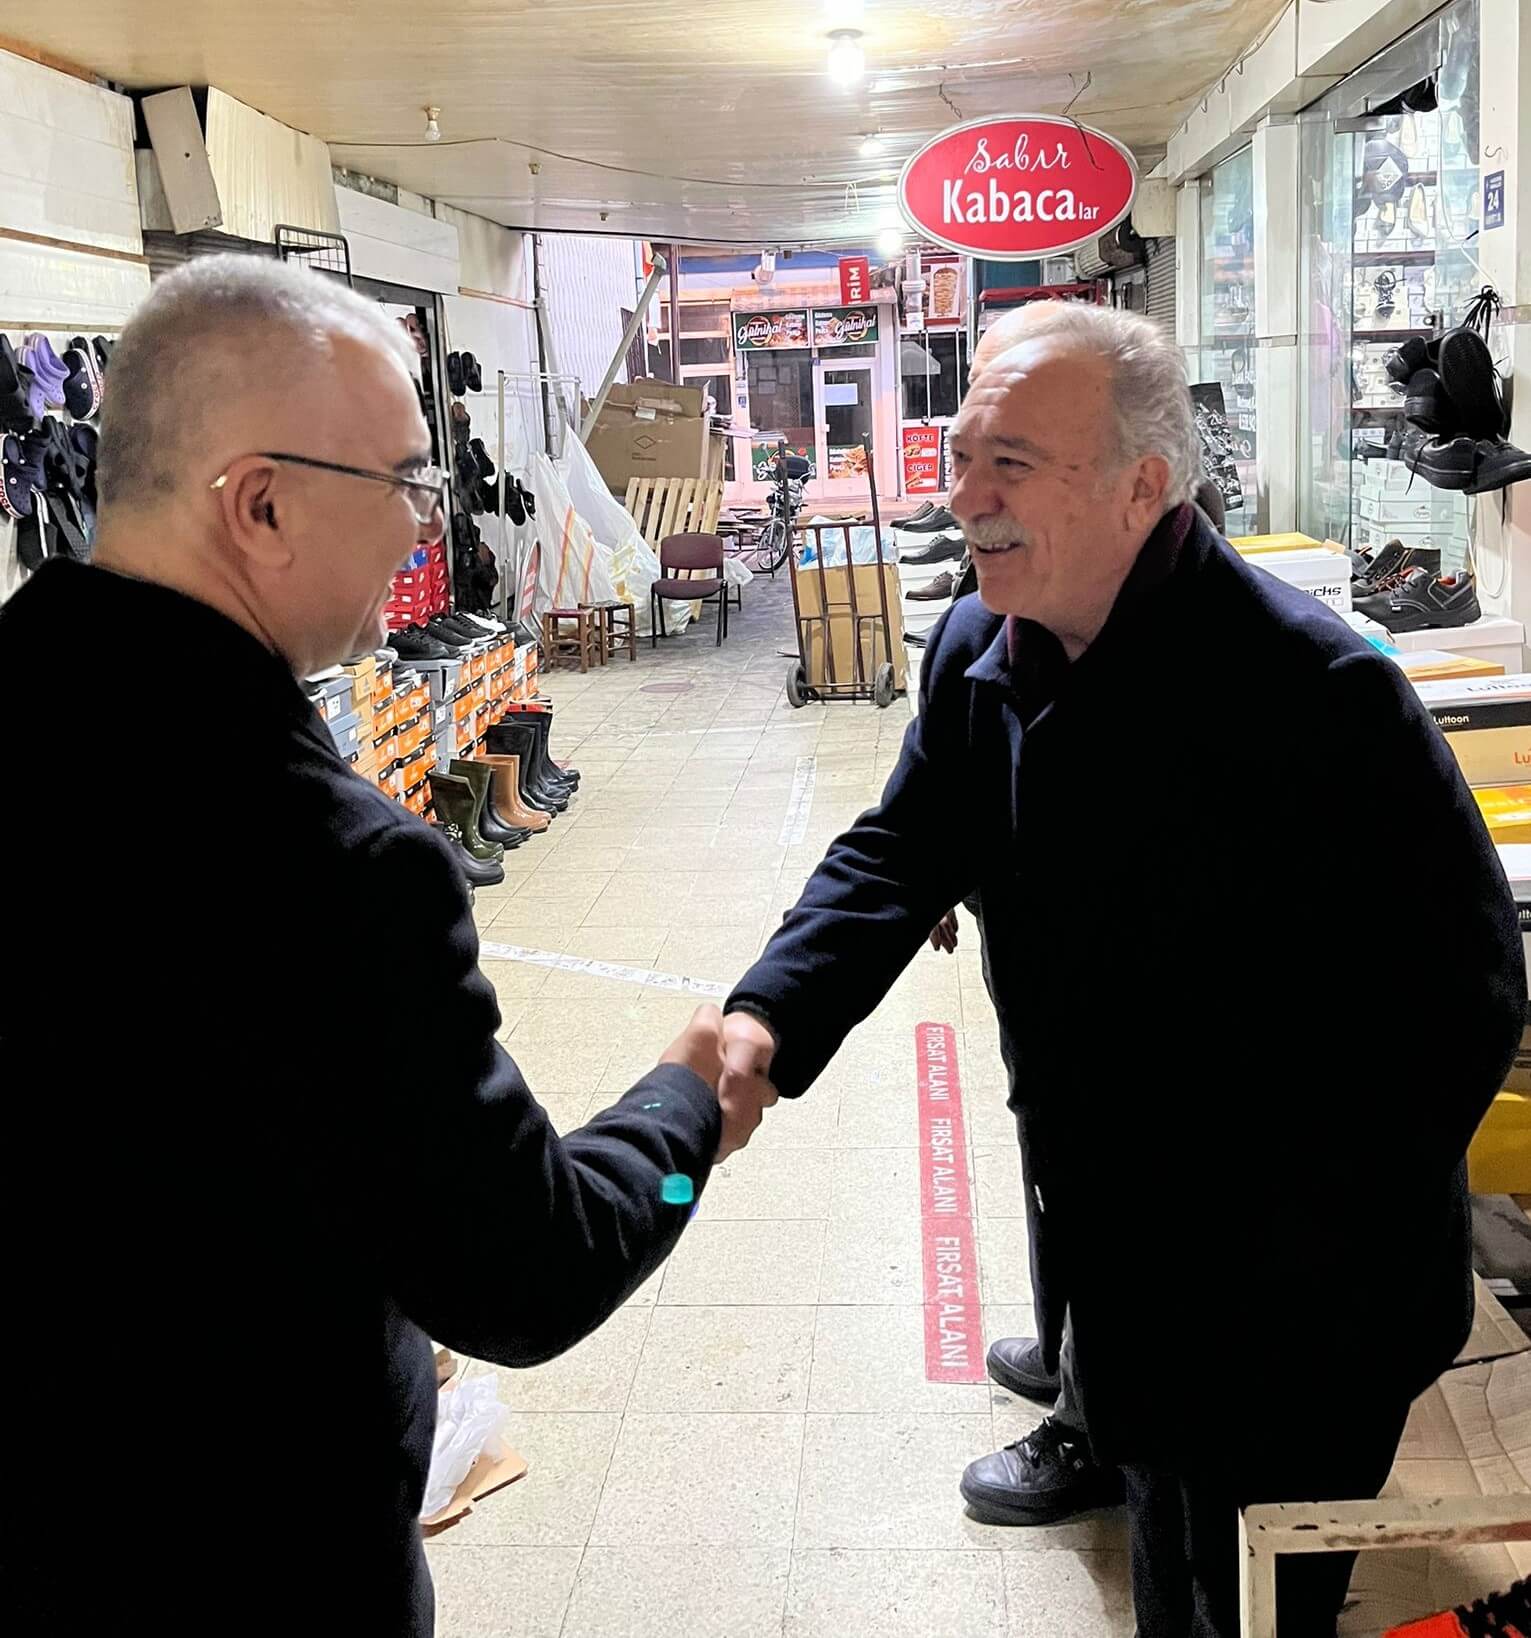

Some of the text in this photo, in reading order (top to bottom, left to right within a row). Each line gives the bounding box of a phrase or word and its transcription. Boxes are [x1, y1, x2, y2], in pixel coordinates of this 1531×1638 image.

[1487, 189, 1499, 212] 24
[926, 1026, 950, 1101] FIRSAT ALANI
[930, 1117, 959, 1214] FIRSAT ALANI
[935, 1235, 969, 1368] FIRSAT ALANI
